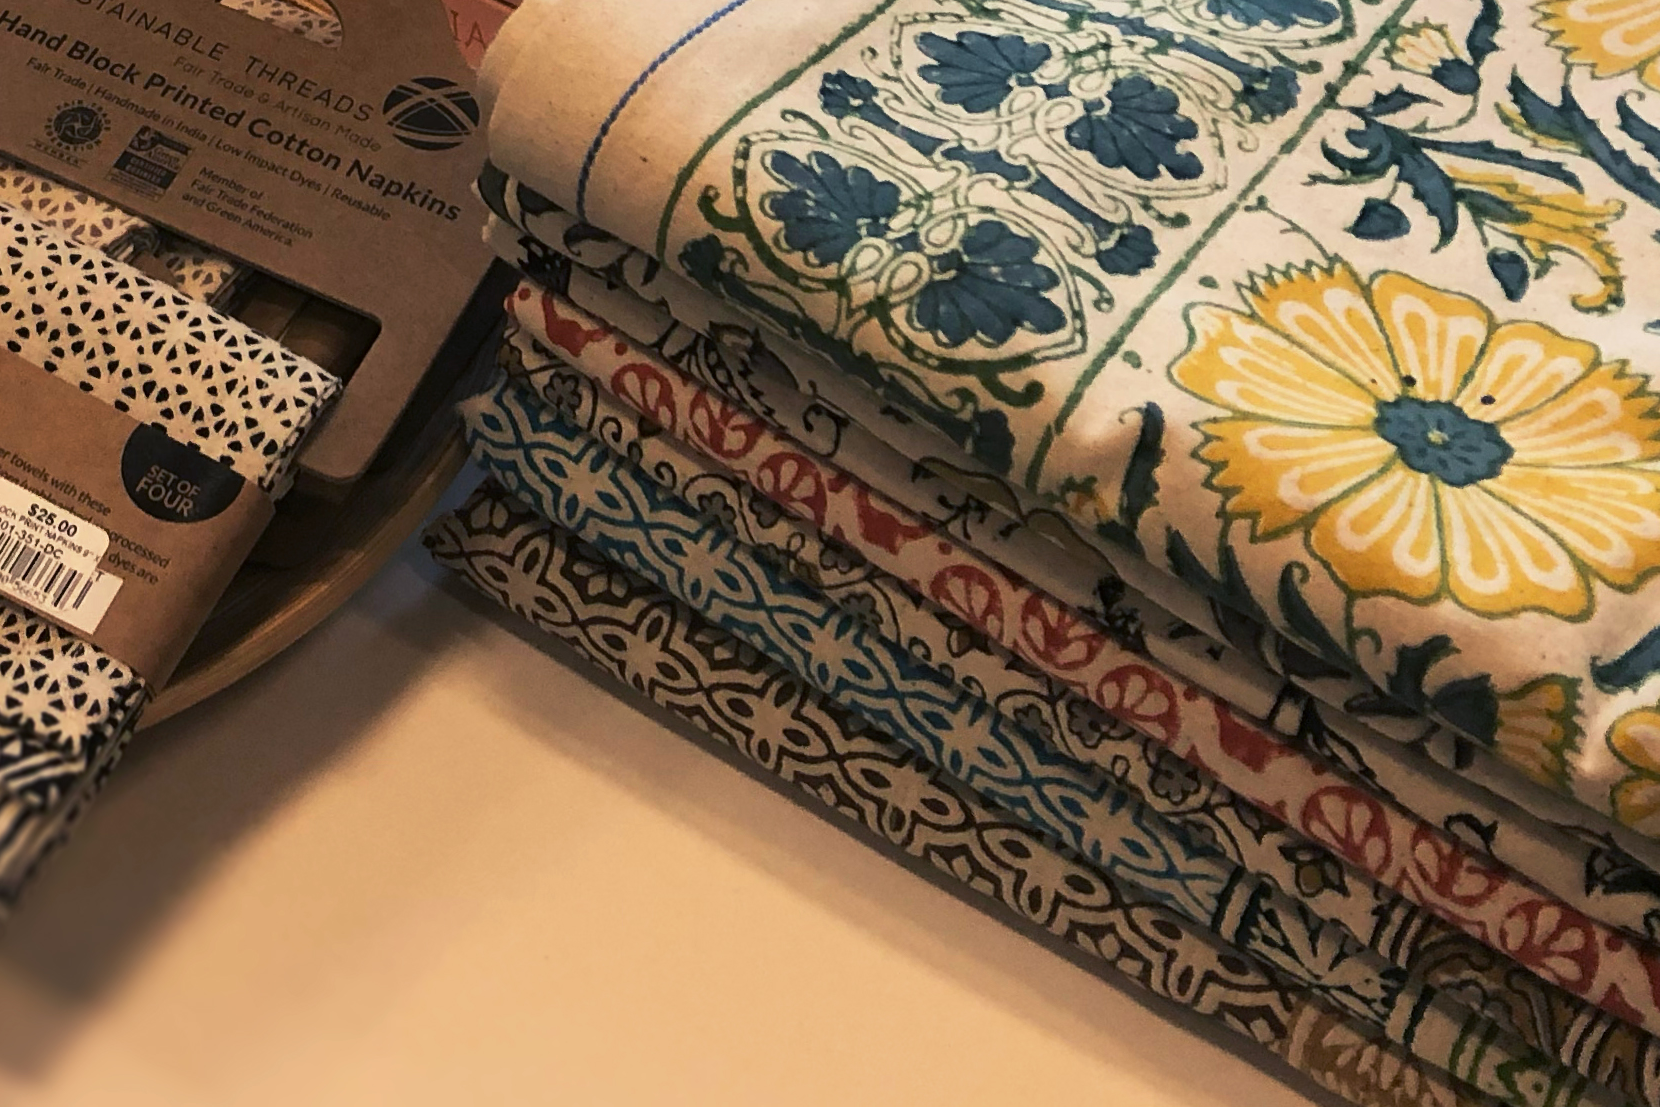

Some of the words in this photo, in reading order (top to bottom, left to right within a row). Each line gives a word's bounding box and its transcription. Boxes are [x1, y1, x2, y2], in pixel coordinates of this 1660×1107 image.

[173, 55, 206, 78] Fair
[211, 70, 255, 99] Trade
[273, 99, 331, 133] Artisan
[334, 125, 382, 153] Made
[244, 55, 374, 122] THREADS
[26, 56, 51, 75] Fair
[54, 69, 87, 91] Trade
[94, 85, 161, 120] Handmade
[161, 112, 175, 127] in
[174, 116, 208, 142] India
[215, 139, 243, 157] Low
[242, 149, 293, 178] Impact
[289, 170, 323, 193] Dyes
[330, 189, 391, 221] Reusable
[66, 40, 141, 86] Block
[143, 73, 246, 128] Printed
[247, 118, 341, 171] Cotton
[345, 158, 462, 222] Napkins
[182, 192, 206, 207] and
[205, 201, 243, 225] Green
[198, 166, 247, 195] Member
[249, 190, 265, 201] of
[190, 179, 214, 195] Fair
[216, 189, 249, 211] Trade
[249, 205, 313, 239] Federation
[10, 453, 50, 483] towels
[50, 475, 78, 497] with
[78, 491, 111, 517] these
[135, 476, 194, 517] FOUR
[147, 464, 179, 487] SET
[176, 480, 201, 497] OF
[27, 503, 78, 537] $25.00
[109, 553, 136, 577] dyes
[135, 569, 159, 585] are
